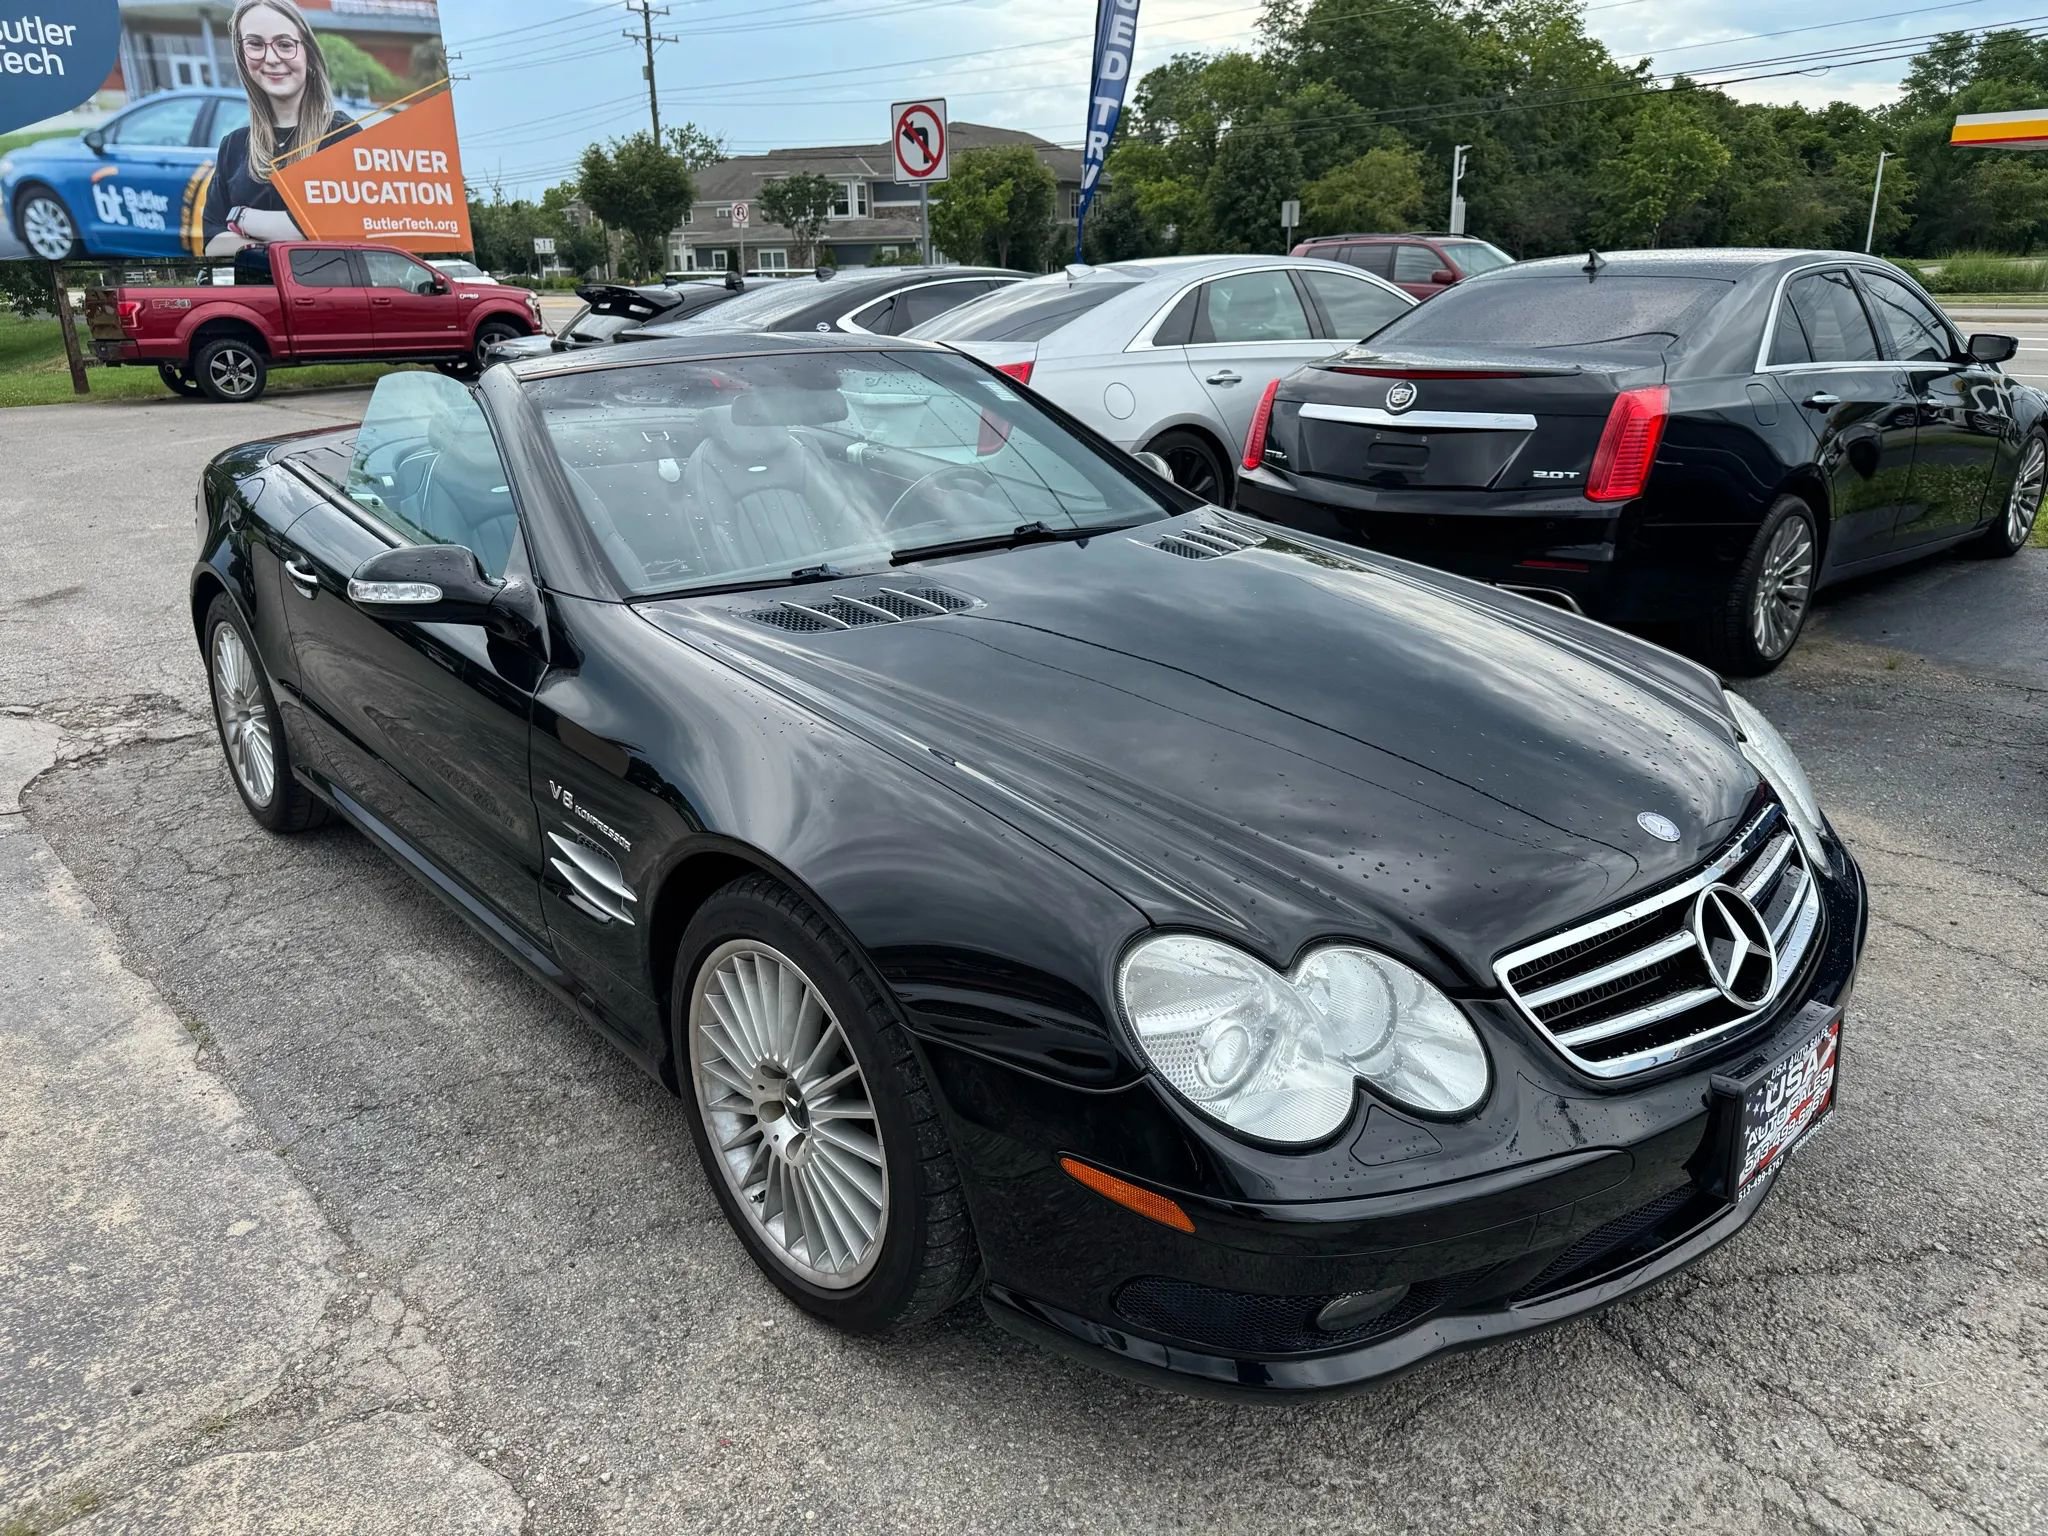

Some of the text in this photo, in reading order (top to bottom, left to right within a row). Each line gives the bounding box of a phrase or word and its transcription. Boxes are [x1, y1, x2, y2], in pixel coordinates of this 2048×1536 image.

[0, 15, 77, 46] utler
[353, 148, 448, 173] DRIVER
[304, 180, 454, 205] EDUCATION
[363, 217, 458, 233] ButlerTech.org
[549, 779, 632, 852] V8 KOMPRESSOR
[1771, 1061, 1787, 1079] USA
[1788, 1045, 1809, 1070] AUTO
[1765, 1048, 1819, 1113] USA
[1746, 1067, 1830, 1150] AUTO SALES
